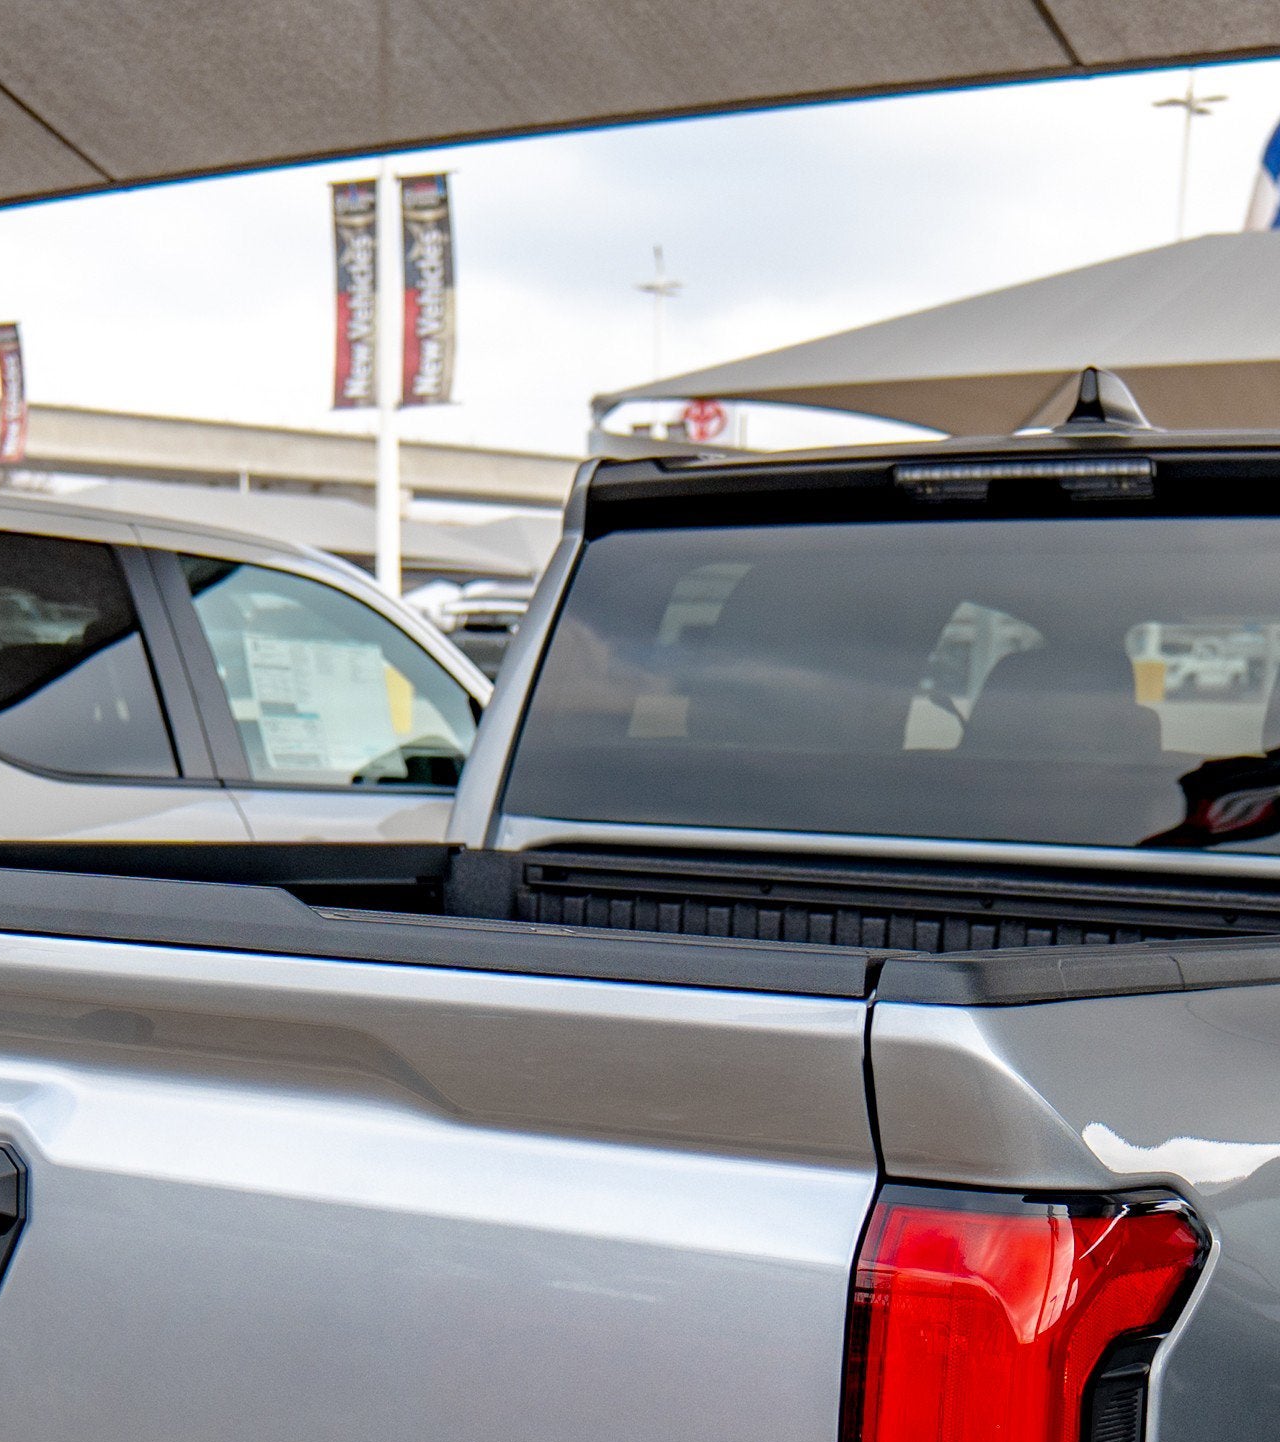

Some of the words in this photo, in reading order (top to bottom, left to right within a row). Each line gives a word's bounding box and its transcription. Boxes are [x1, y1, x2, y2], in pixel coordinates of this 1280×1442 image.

[346, 234, 373, 342] Vehicles
[415, 228, 445, 337] Vehicles
[344, 341, 371, 398] New
[413, 337, 444, 396] New
